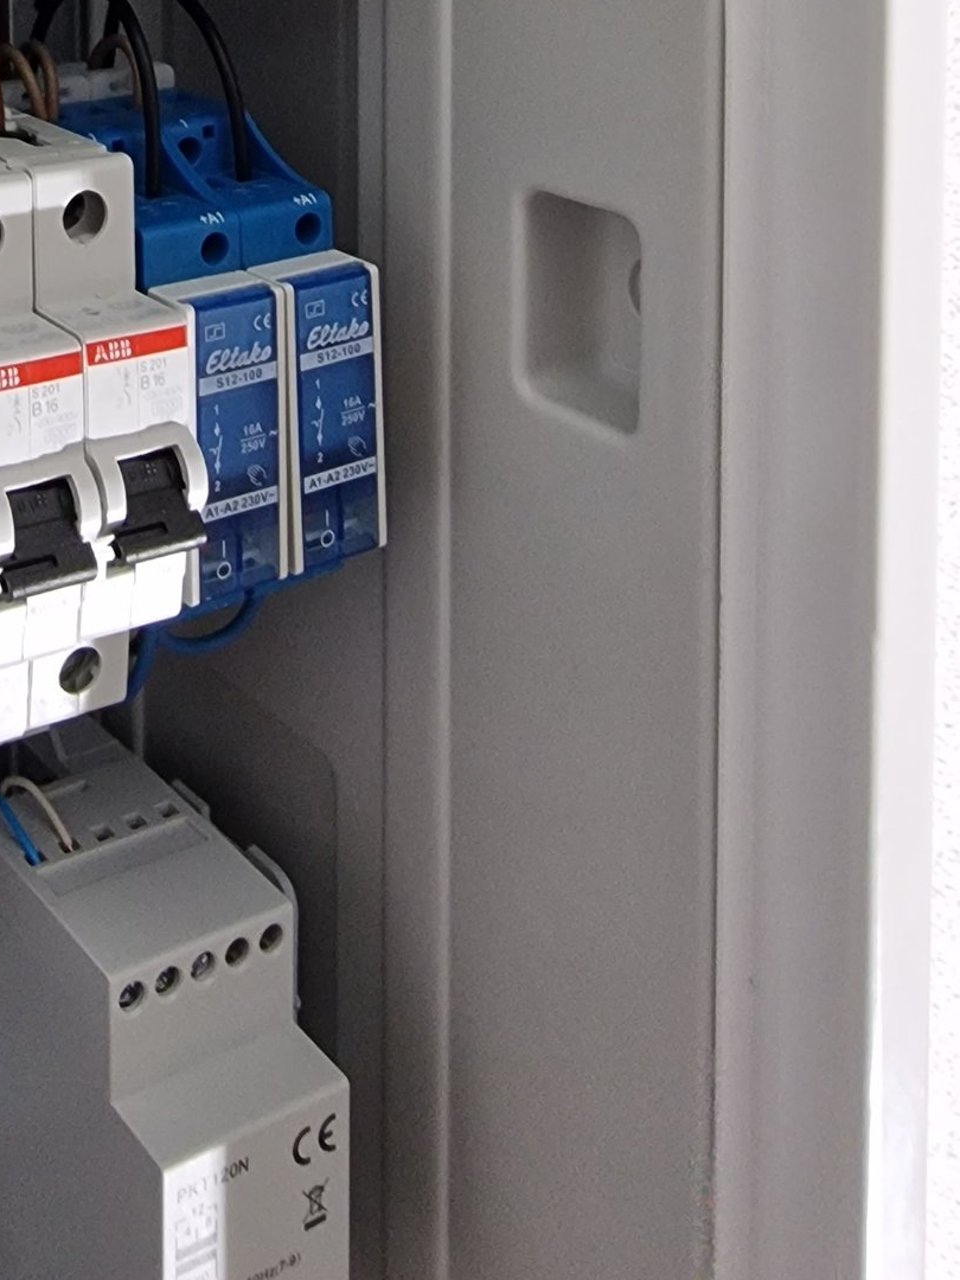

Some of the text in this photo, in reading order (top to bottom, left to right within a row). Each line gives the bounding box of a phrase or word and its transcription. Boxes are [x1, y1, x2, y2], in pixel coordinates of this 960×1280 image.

[307, 317, 369, 350] Eltako
[94, 339, 132, 363] ABB
[206, 341, 272, 374] Eltako
[317, 343, 361, 364] S12-100
[141, 375, 150, 390] B
[216, 367, 262, 389] S12-100
[32, 398, 58, 417] B 16
[241, 438, 266, 454] 250V
[309, 472, 340, 489] A1-A2
[205, 501, 239, 519] A1-A2
[292, 1113, 336, 1166] CE
